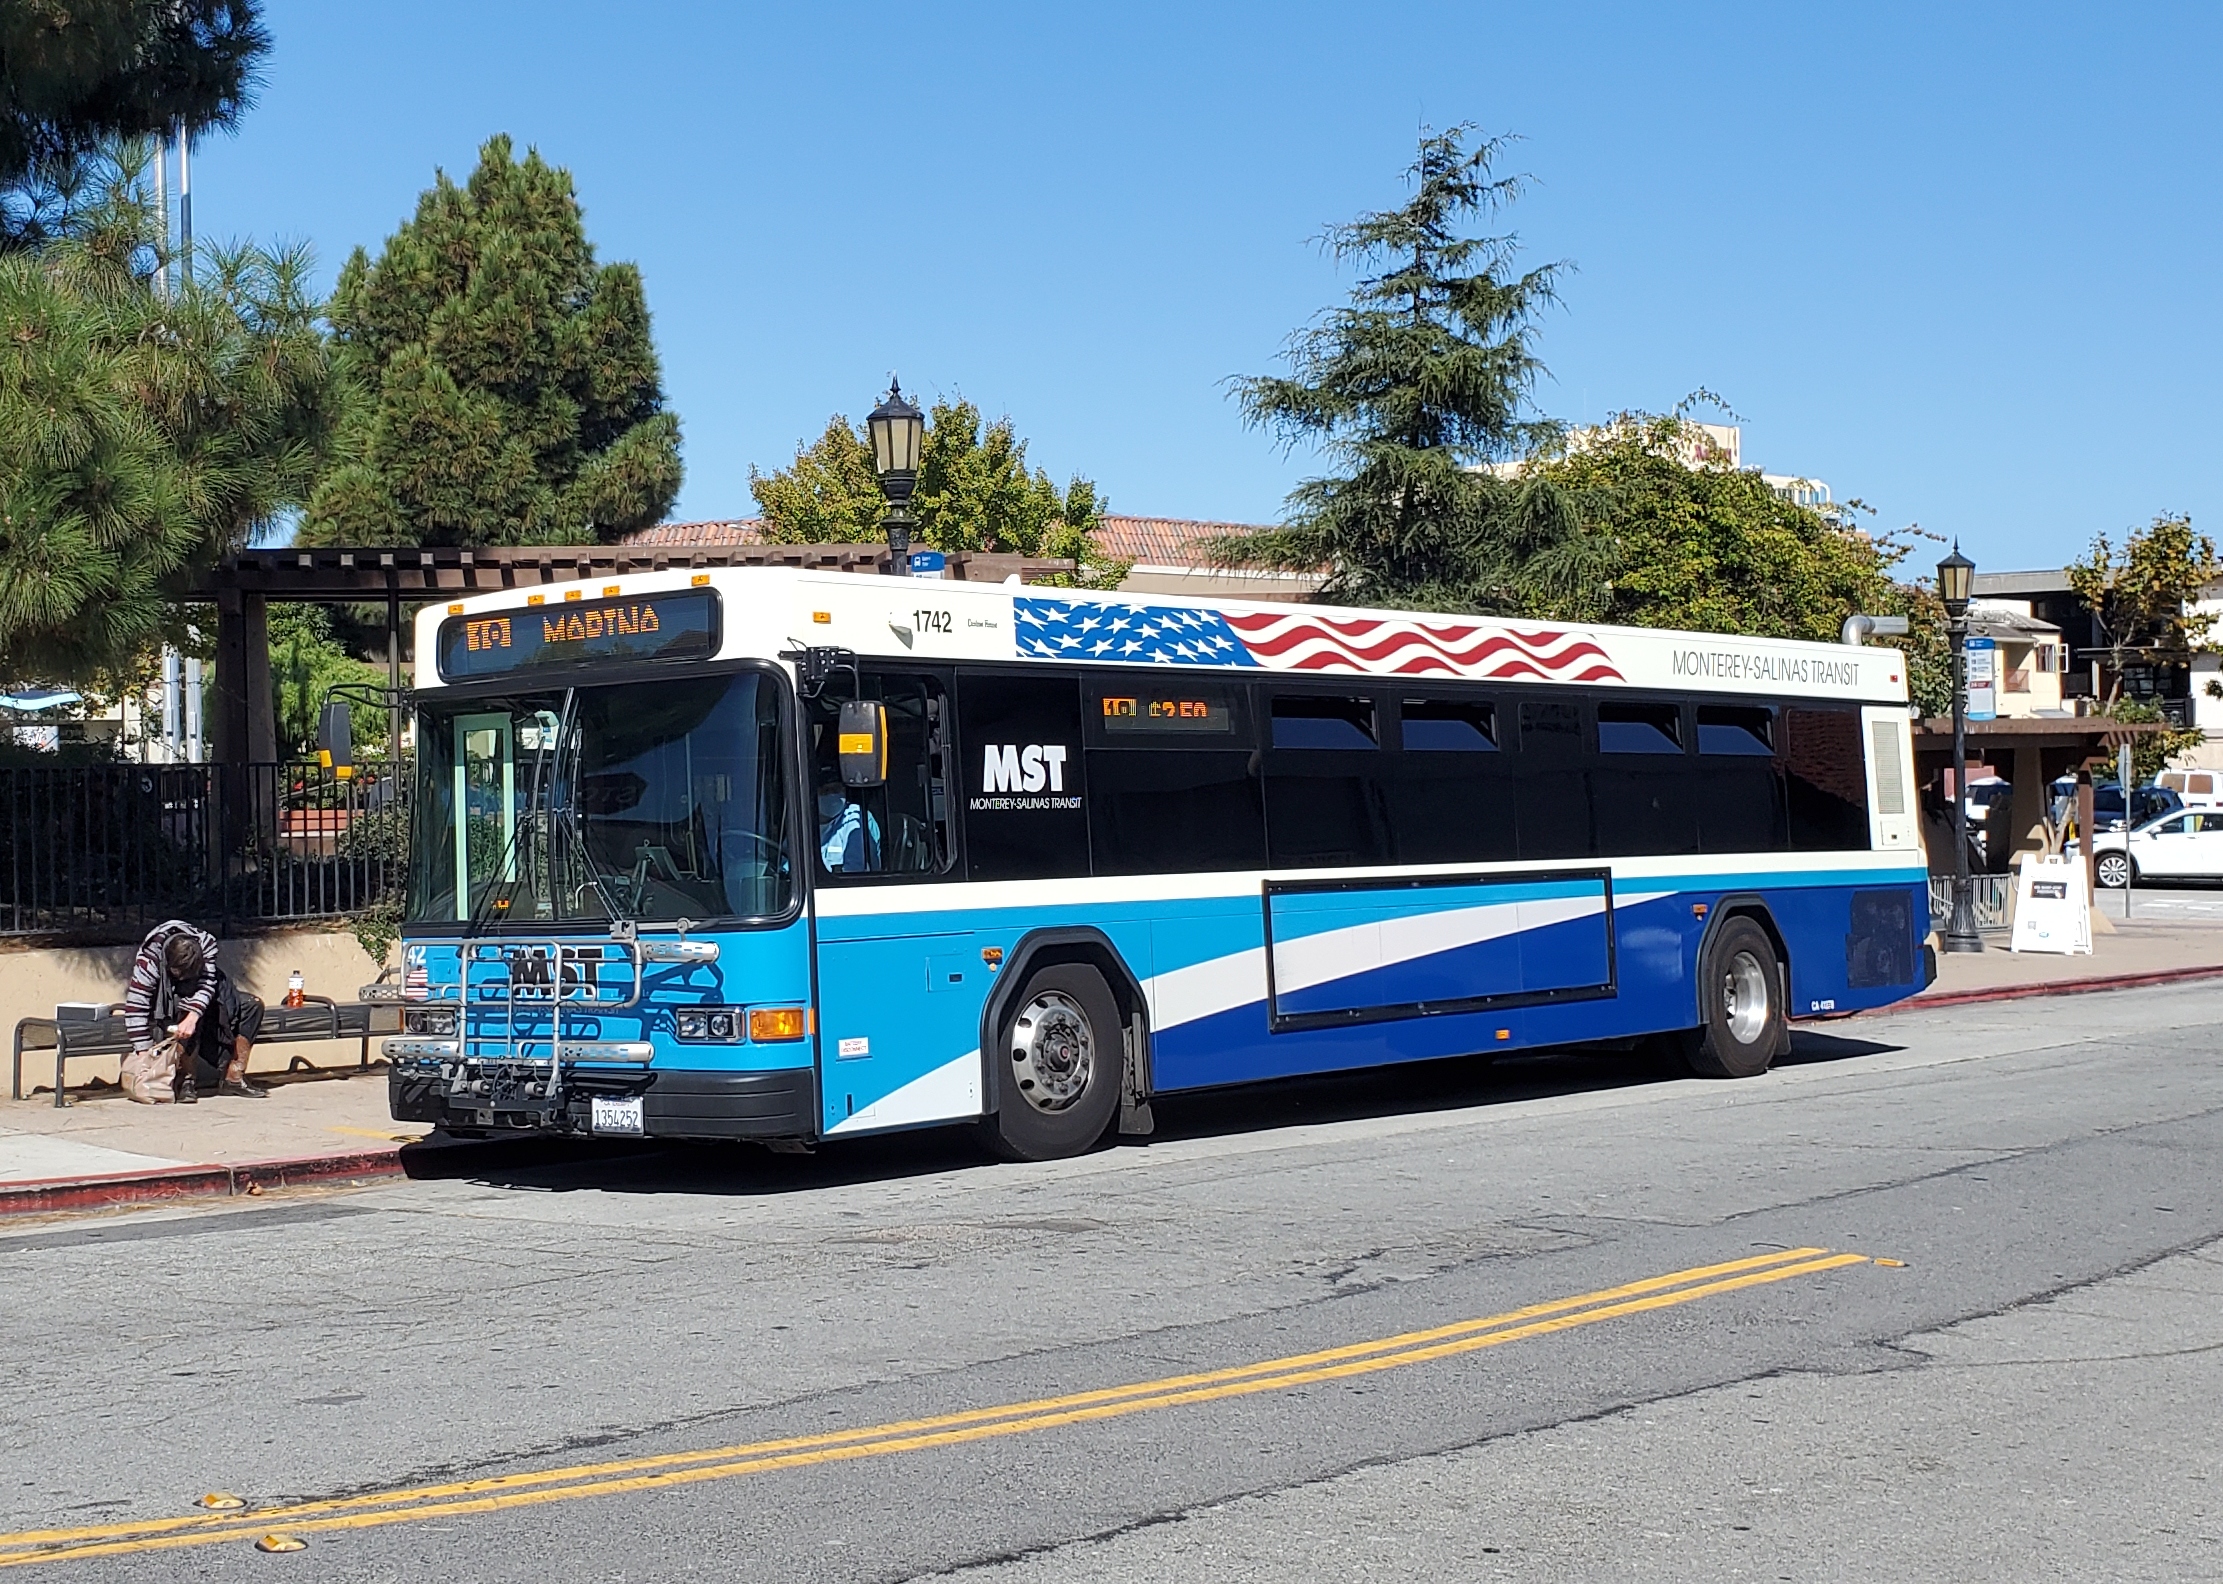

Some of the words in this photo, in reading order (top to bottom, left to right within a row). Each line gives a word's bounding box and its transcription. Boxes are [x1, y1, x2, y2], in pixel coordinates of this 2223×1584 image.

[912, 609, 953, 634] 1742
[1672, 650, 1808, 683] MONTEREY-SALINAS
[1811, 660, 1860, 686] TRANSIT
[983, 744, 1067, 793] MST
[969, 797, 1050, 810] MONTEREY-SALINAS
[1051, 796, 1083, 809] TRANSIT
[512, 945, 605, 999] MST
[595, 1109, 639, 1127] 1354252
